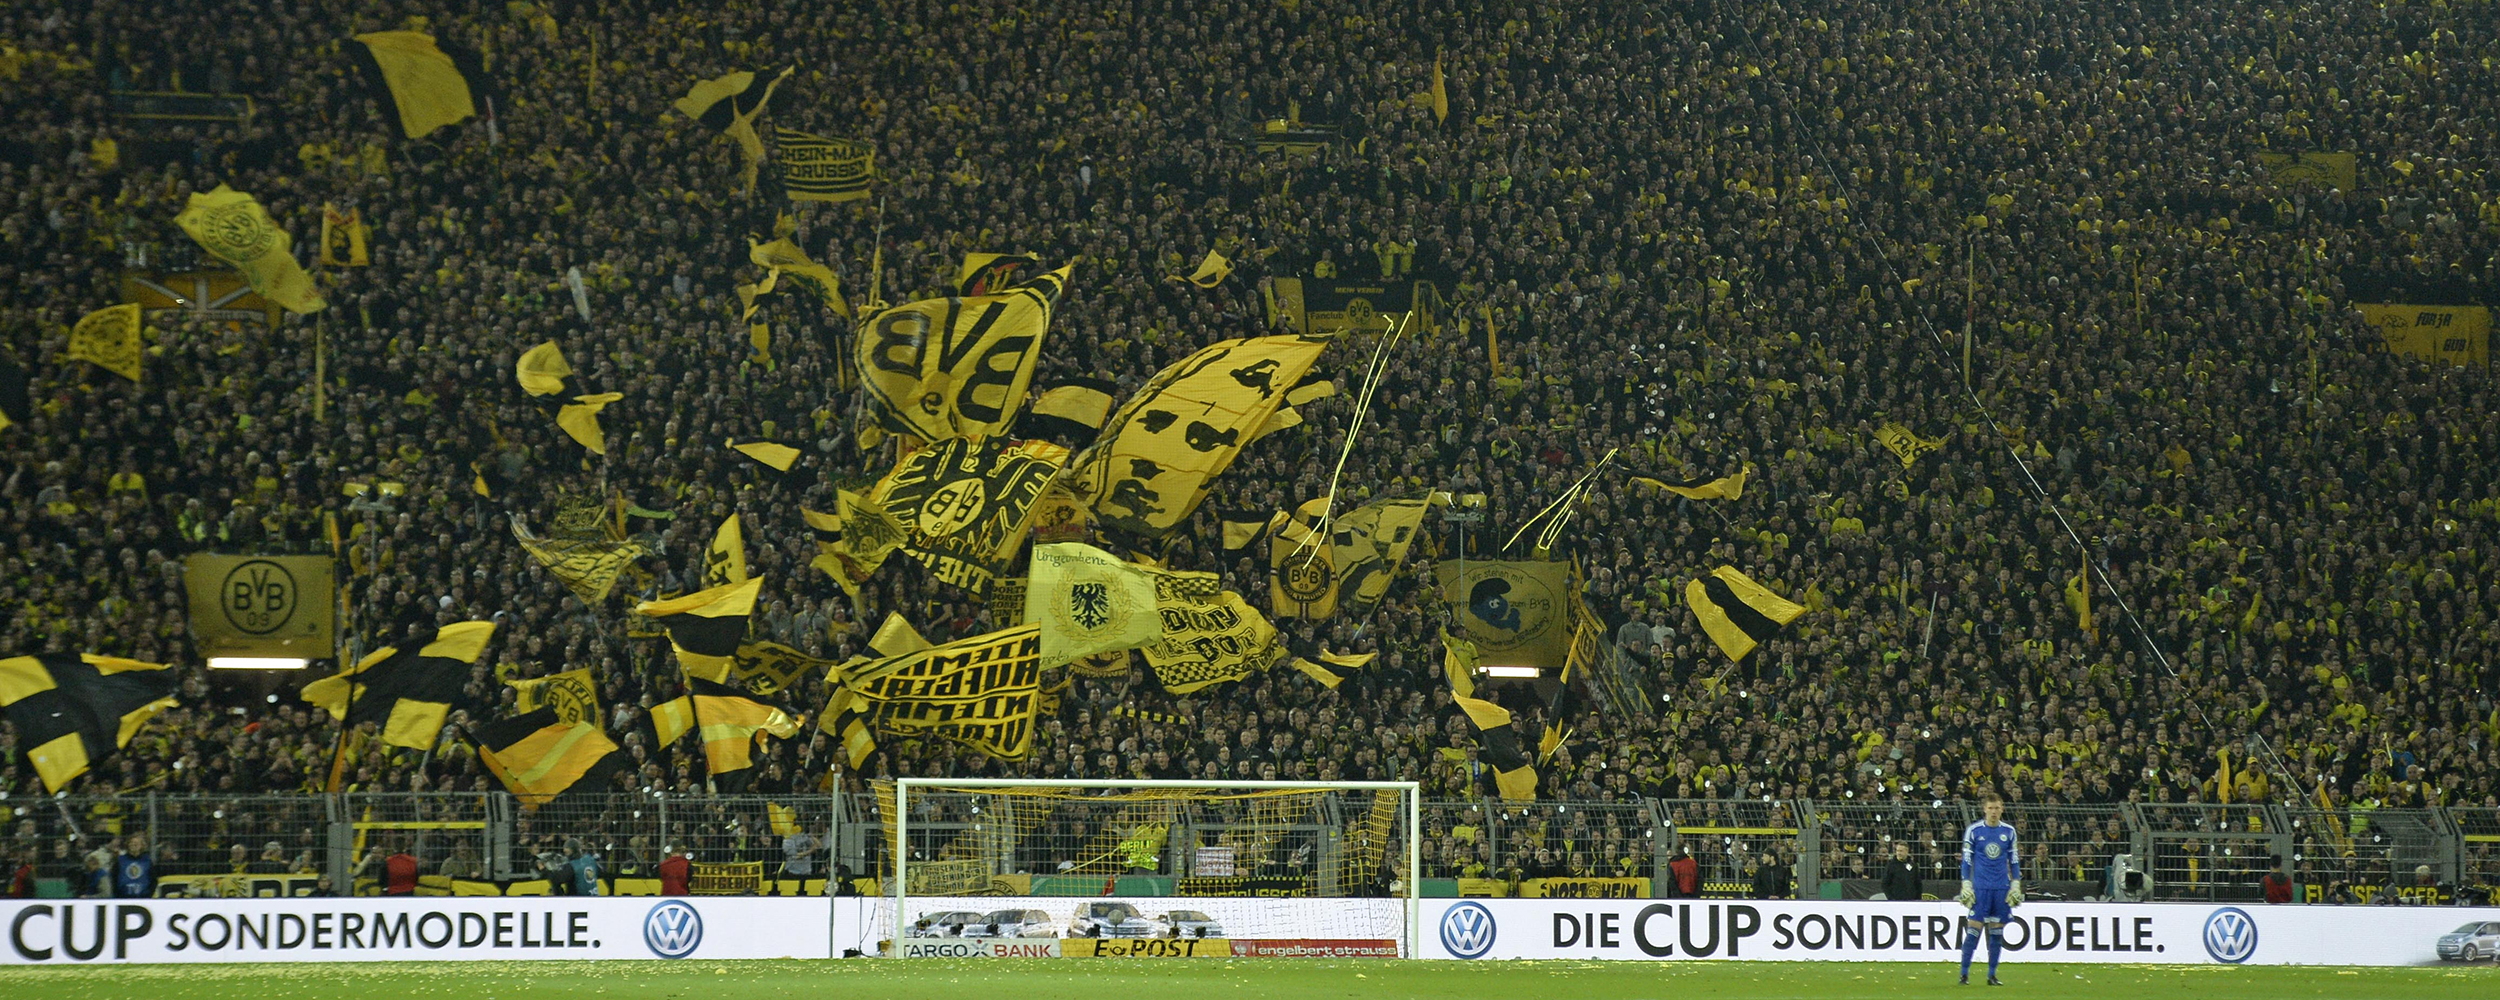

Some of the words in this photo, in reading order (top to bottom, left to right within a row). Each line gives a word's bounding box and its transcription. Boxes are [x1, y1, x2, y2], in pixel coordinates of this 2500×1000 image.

[1350, 301, 1371, 317] BVB
[1291, 566, 1319, 584] BVB
[234, 568, 284, 611] BVB
[248, 611, 270, 627] 09
[10, 903, 152, 960] CUP
[165, 911, 602, 951] SONDERMODELLE.
[1553, 912, 1620, 948] DIE
[1633, 902, 1761, 958] CUP
[904, 944, 968, 957] TARGO
[994, 944, 1052, 957] BANK
[1257, 945, 1333, 957] engelbert
[1334, 945, 1397, 956] strauss
